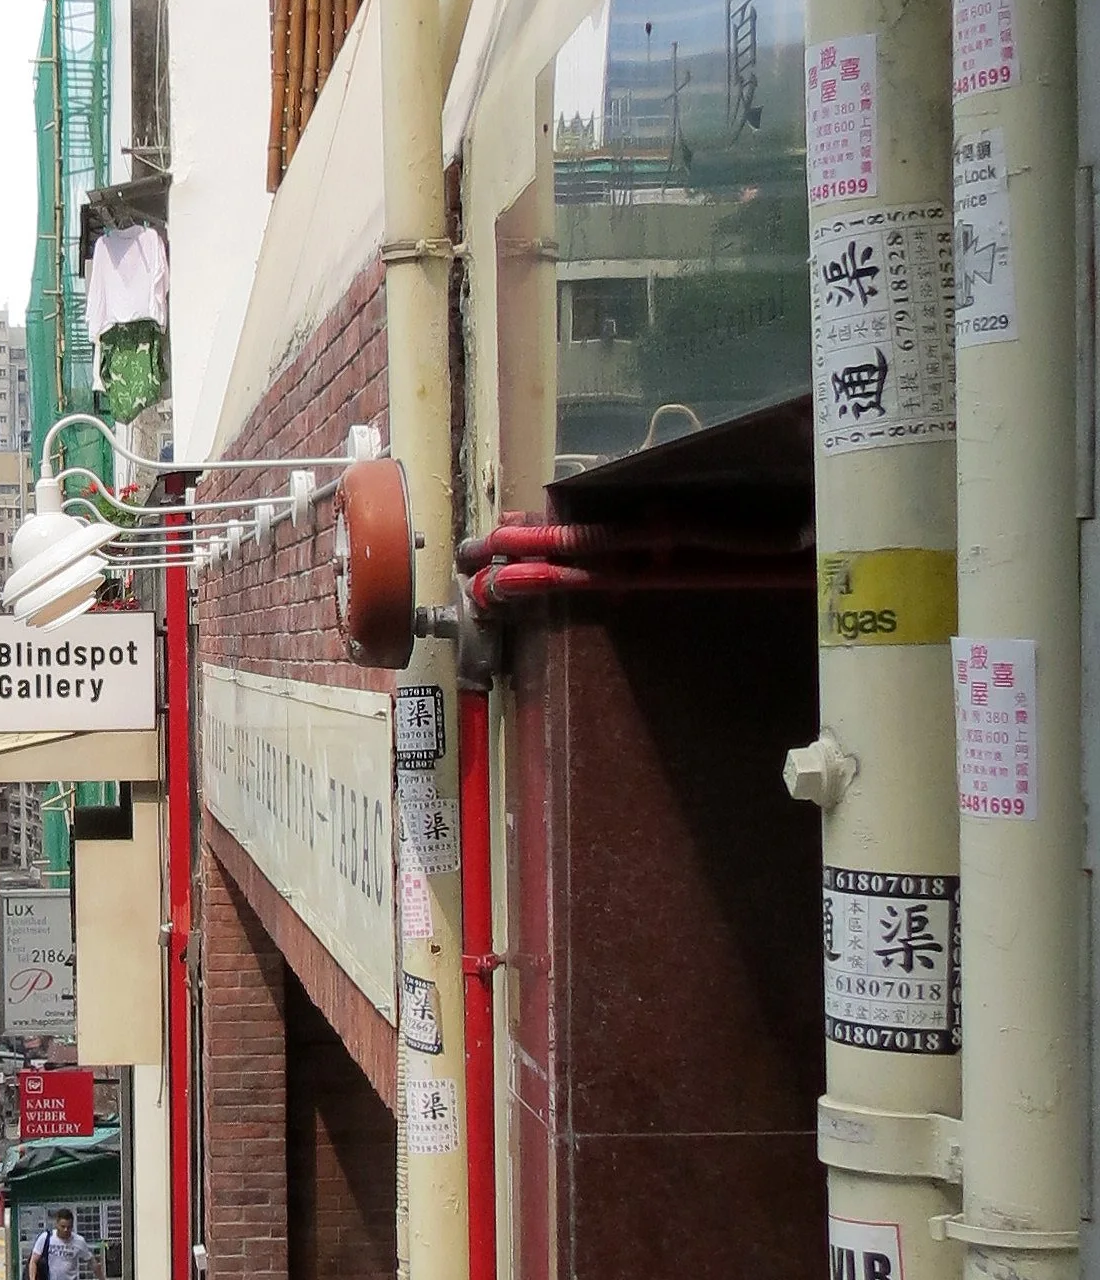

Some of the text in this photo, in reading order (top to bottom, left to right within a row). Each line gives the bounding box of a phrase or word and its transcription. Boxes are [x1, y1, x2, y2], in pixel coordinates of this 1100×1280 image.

[834, 120, 856, 135] 600
[964, 165, 997, 185] Lock
[822, 239, 881, 308] 渠
[886, 228, 916, 353] 67918528
[831, 345, 889, 421] 通
[970, 644, 989, 707] 搬屋
[992, 663, 1015, 688] 喜
[407, 698, 433, 728] 渠
[986, 711, 1010, 725] 380
[986, 731, 1009, 745] 600
[423, 811, 450, 841] 渠
[329, 776, 385, 907] TABAC
[835, 871, 946, 896] 61807018
[6, 898, 34, 916] Lux
[873, 904, 944, 974] 渠
[31, 949, 66, 964] 2186
[835, 974, 942, 1002] 61807018
[833, 1022, 941, 1051] 61807018
[26, 1099, 65, 1108] KARIN
[26, 1111, 67, 1121] WEBER
[420, 1091, 448, 1120] 渠
[26, 1123, 81, 1134] GALLERY
